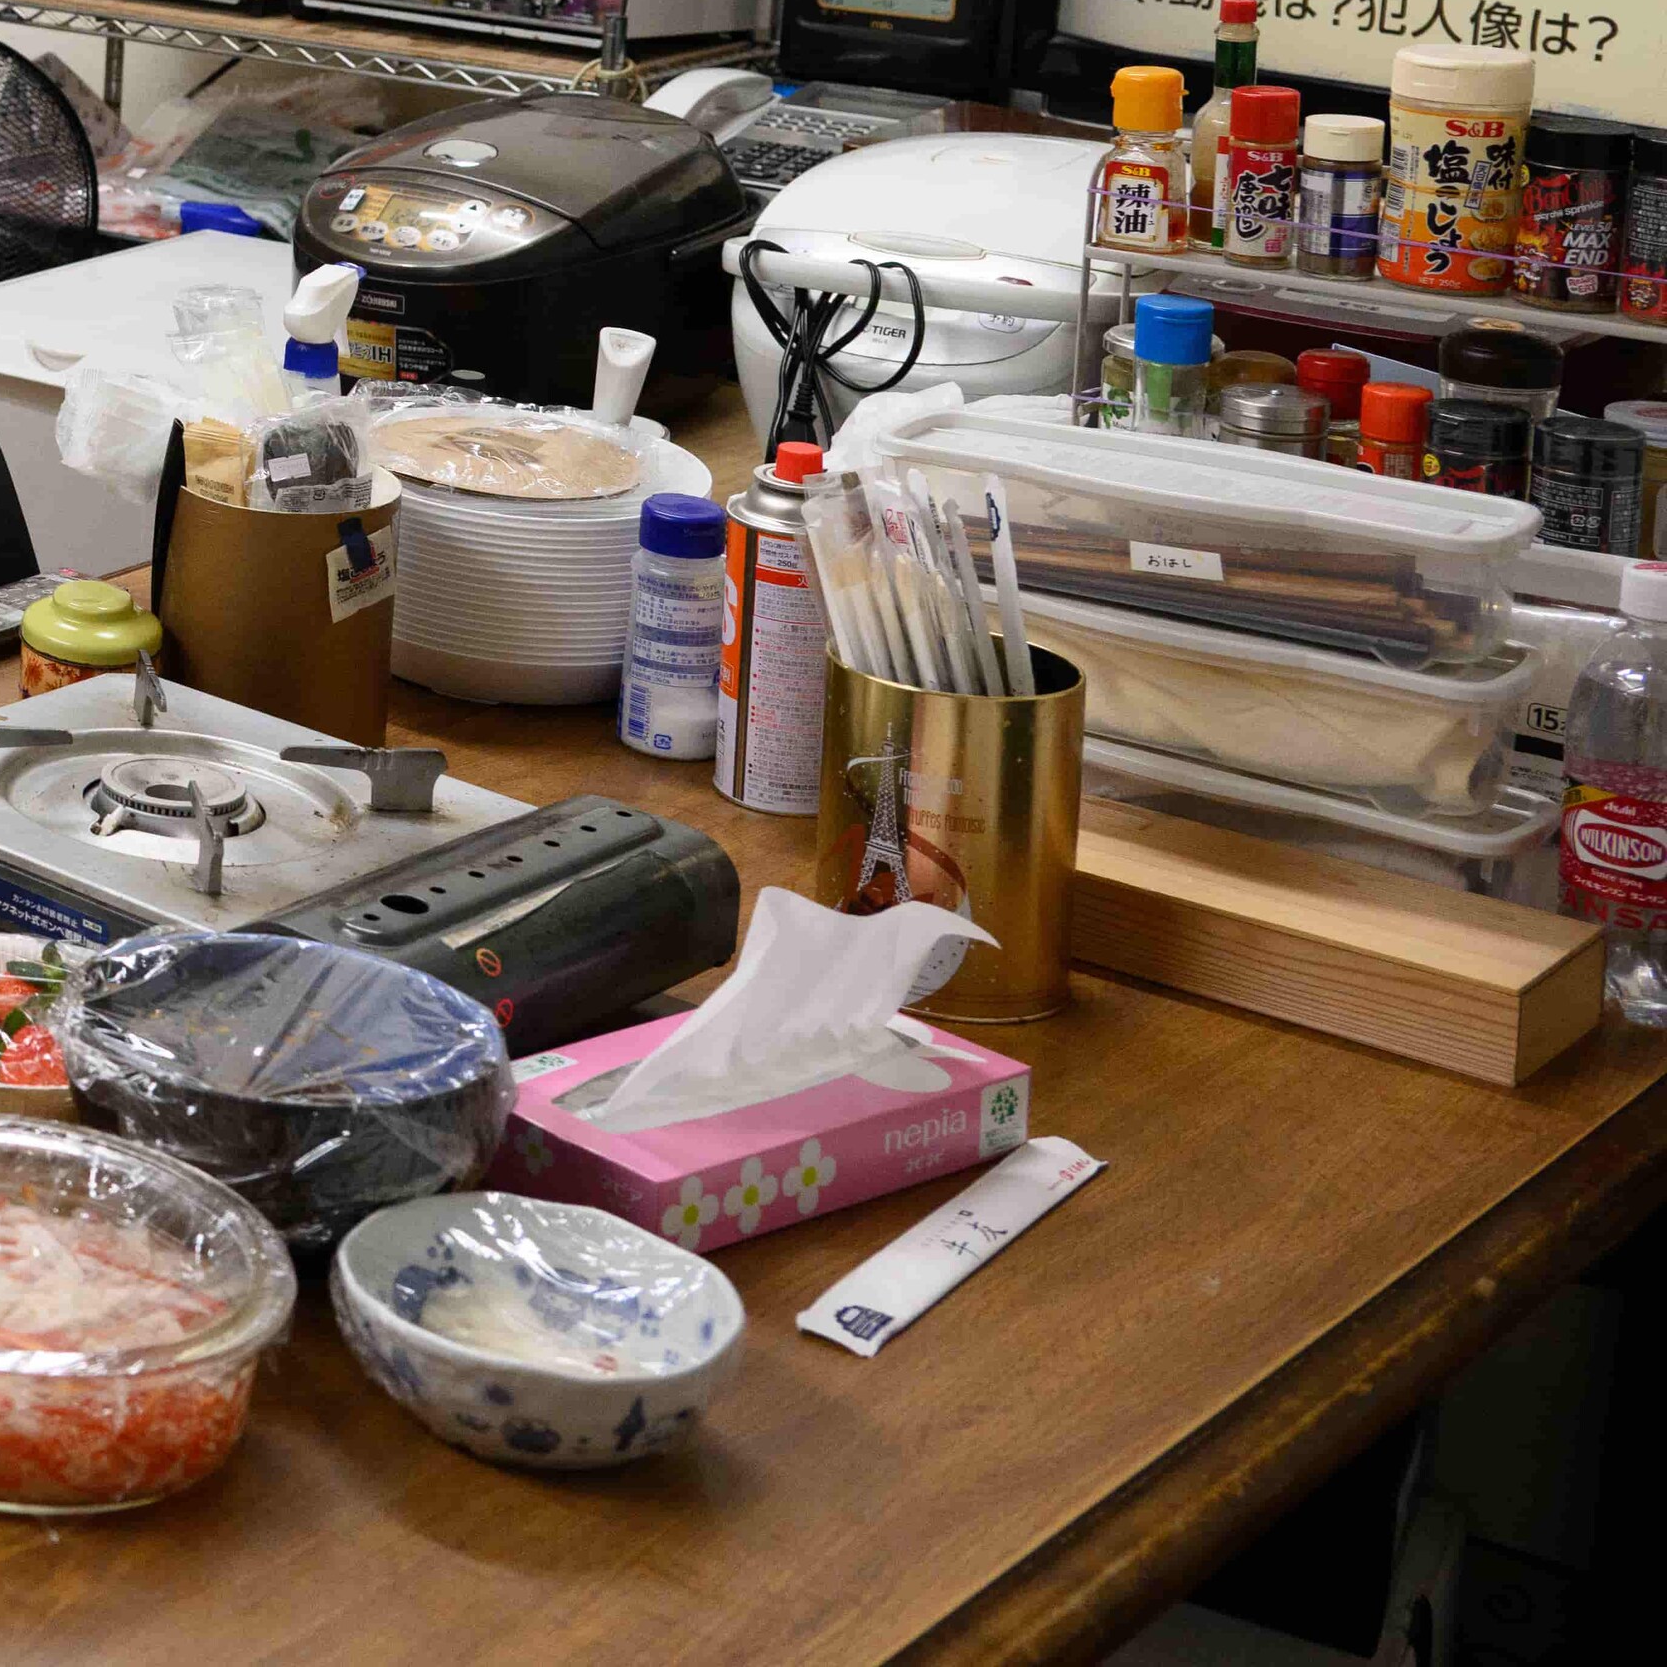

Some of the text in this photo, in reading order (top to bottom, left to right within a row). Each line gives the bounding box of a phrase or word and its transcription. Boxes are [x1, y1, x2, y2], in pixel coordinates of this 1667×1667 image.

[1446, 119, 1505, 138] S&B
[1247, 149, 1284, 163] S&B
[1485, 135, 1517, 191] 味付
[1121, 165, 1152, 177] S&B
[1258, 164, 1294, 221] 七味
[1114, 183, 1152, 234] 辣油
[1562, 232, 1614, 249] MAX
[1563, 249, 1609, 266] END
[1146, 554, 1193, 569] おはし
[1602, 800, 1637, 816] Asahi
[1579, 827, 1663, 862] WILKINSON
[1590, 867, 1616, 883] Since
[1573, 873, 1627, 899] ウィルキンソン
[883, 1108, 967, 1154] nepia
